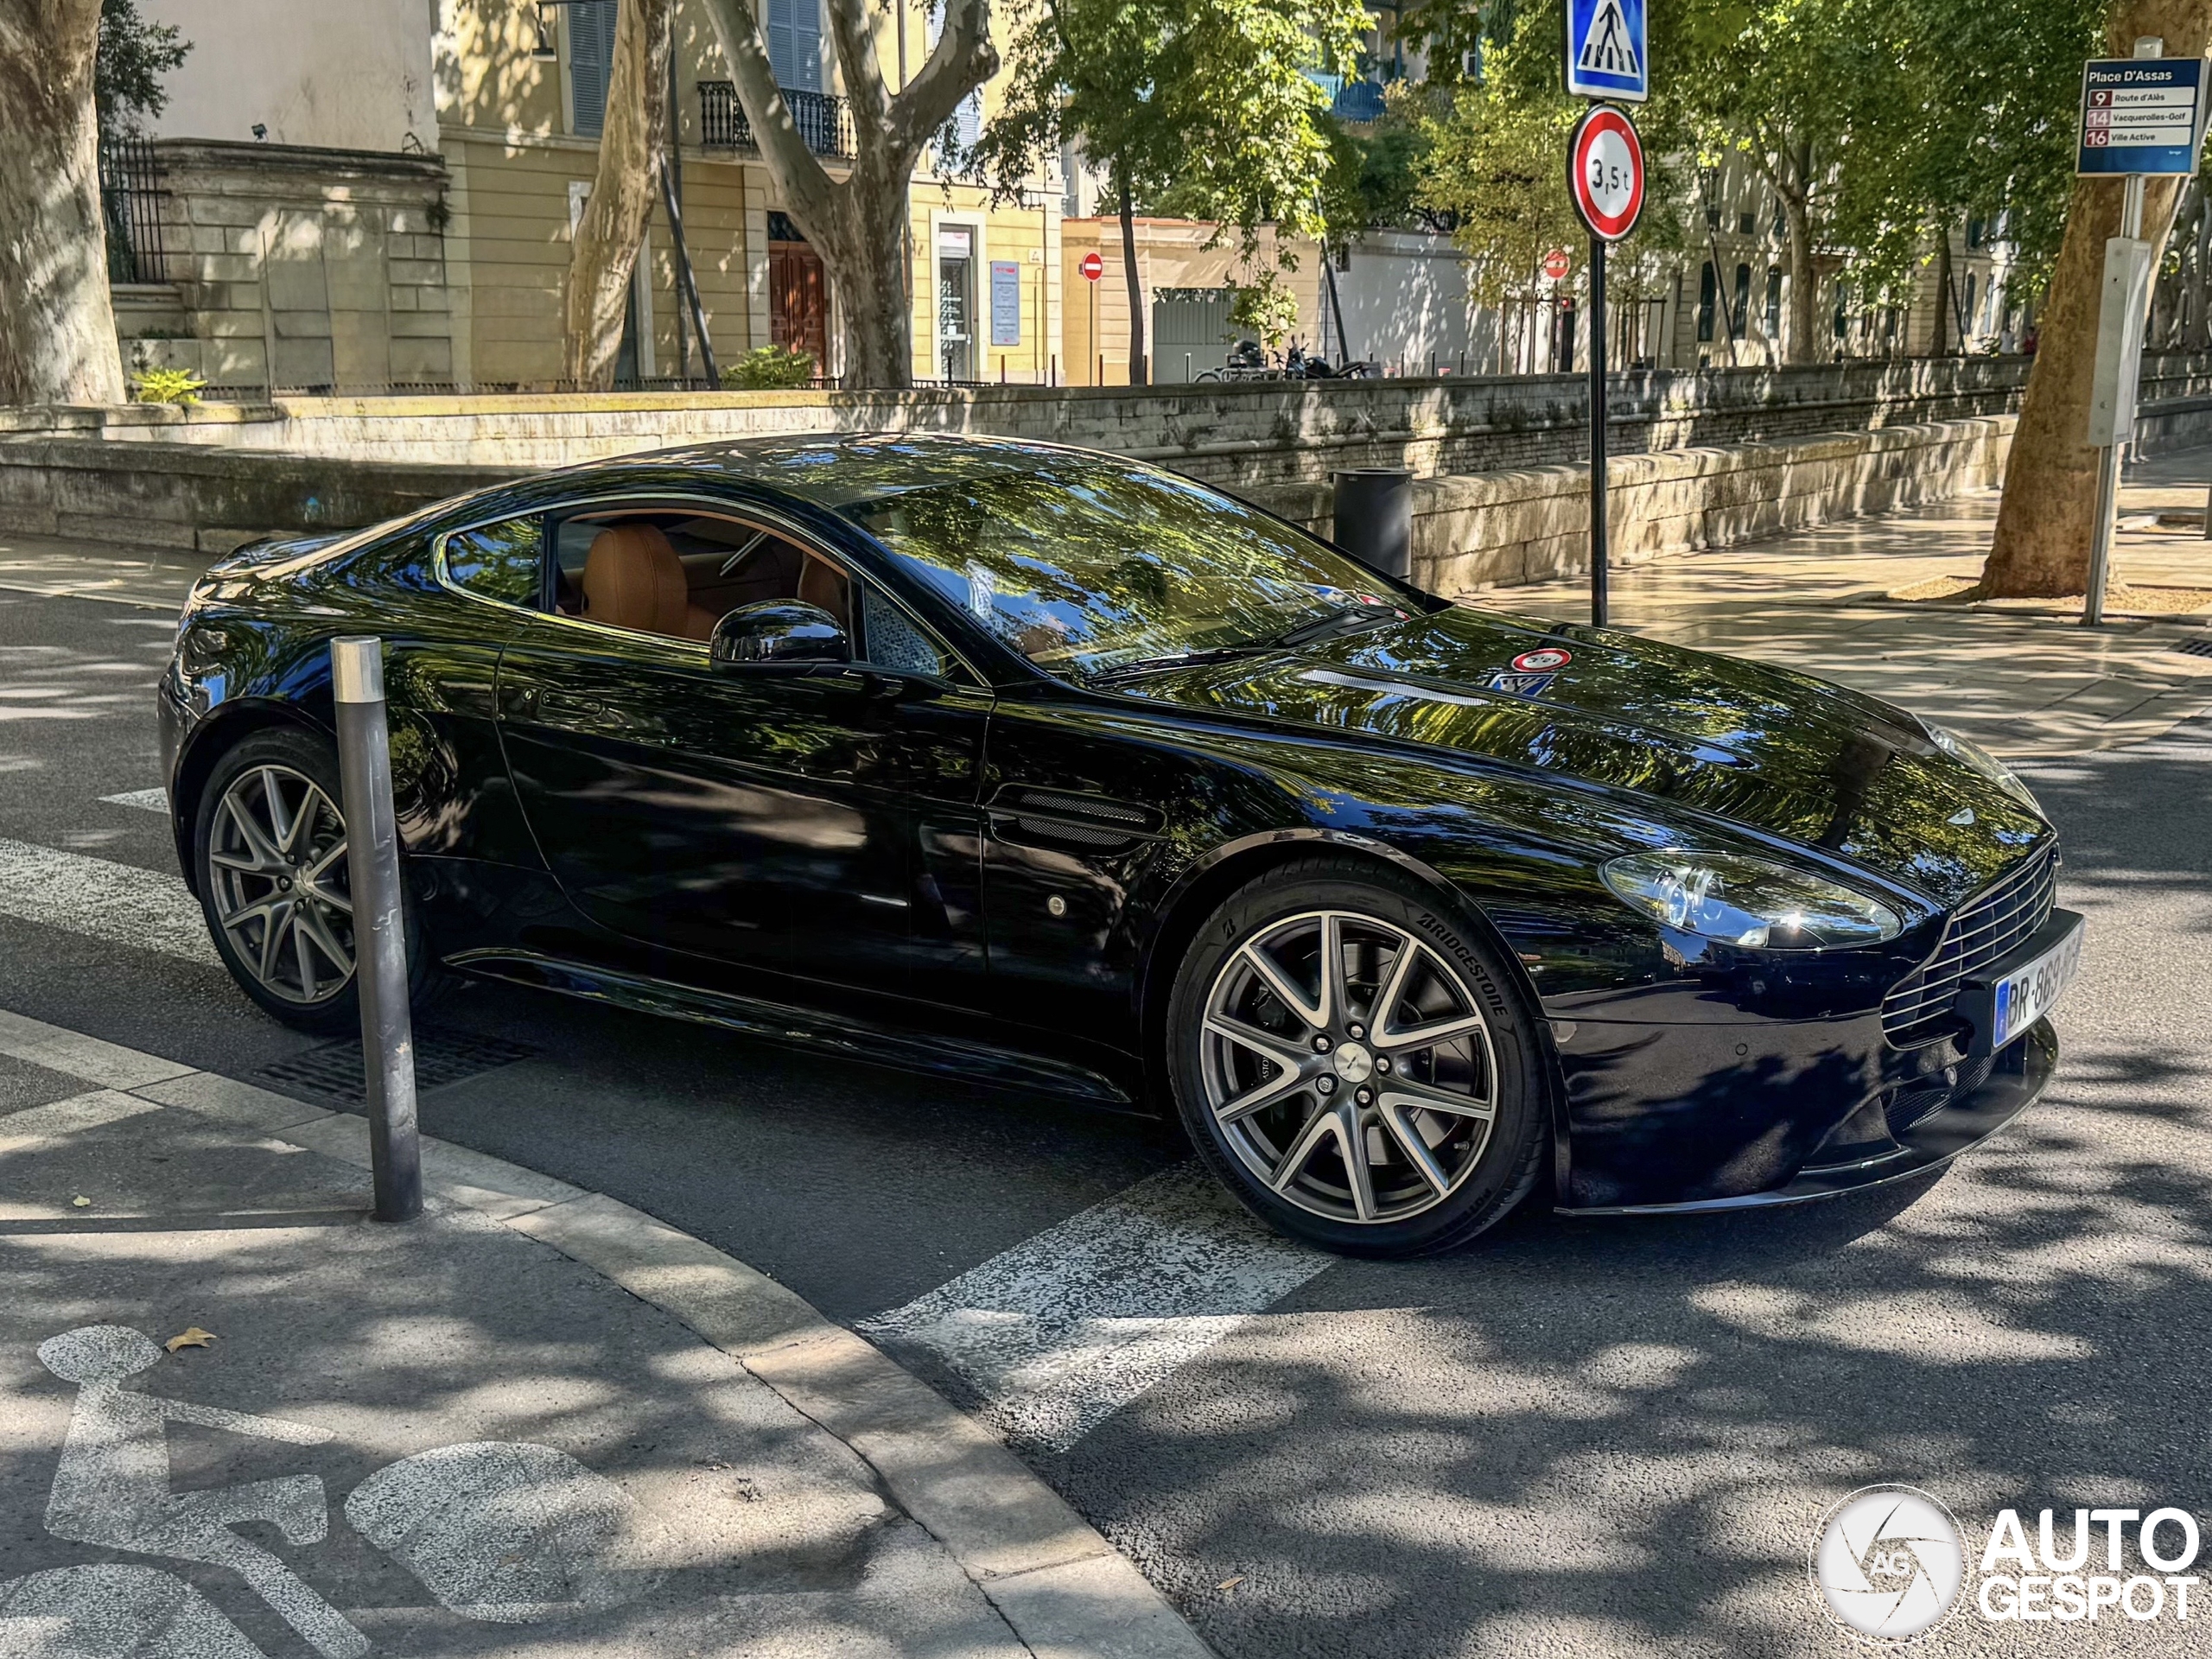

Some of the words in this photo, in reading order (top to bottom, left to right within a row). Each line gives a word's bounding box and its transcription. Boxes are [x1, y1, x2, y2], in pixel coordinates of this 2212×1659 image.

[2088, 72, 2121, 82] Place
[2124, 71, 2172, 82] D'Assas
[2095, 92, 2107, 105] 9
[2140, 92, 2164, 101] d'Alès
[2089, 111, 2108, 126] 14
[2113, 112, 2185, 122] Vacquerolles-Golf
[2088, 131, 2107, 145] 16
[1592, 158, 1619, 195] 3,5
[1624, 171, 1630, 190] t
[1415, 912, 1509, 1017] BRIDGESTONE
[2008, 937, 2079, 1029] BR-869-
